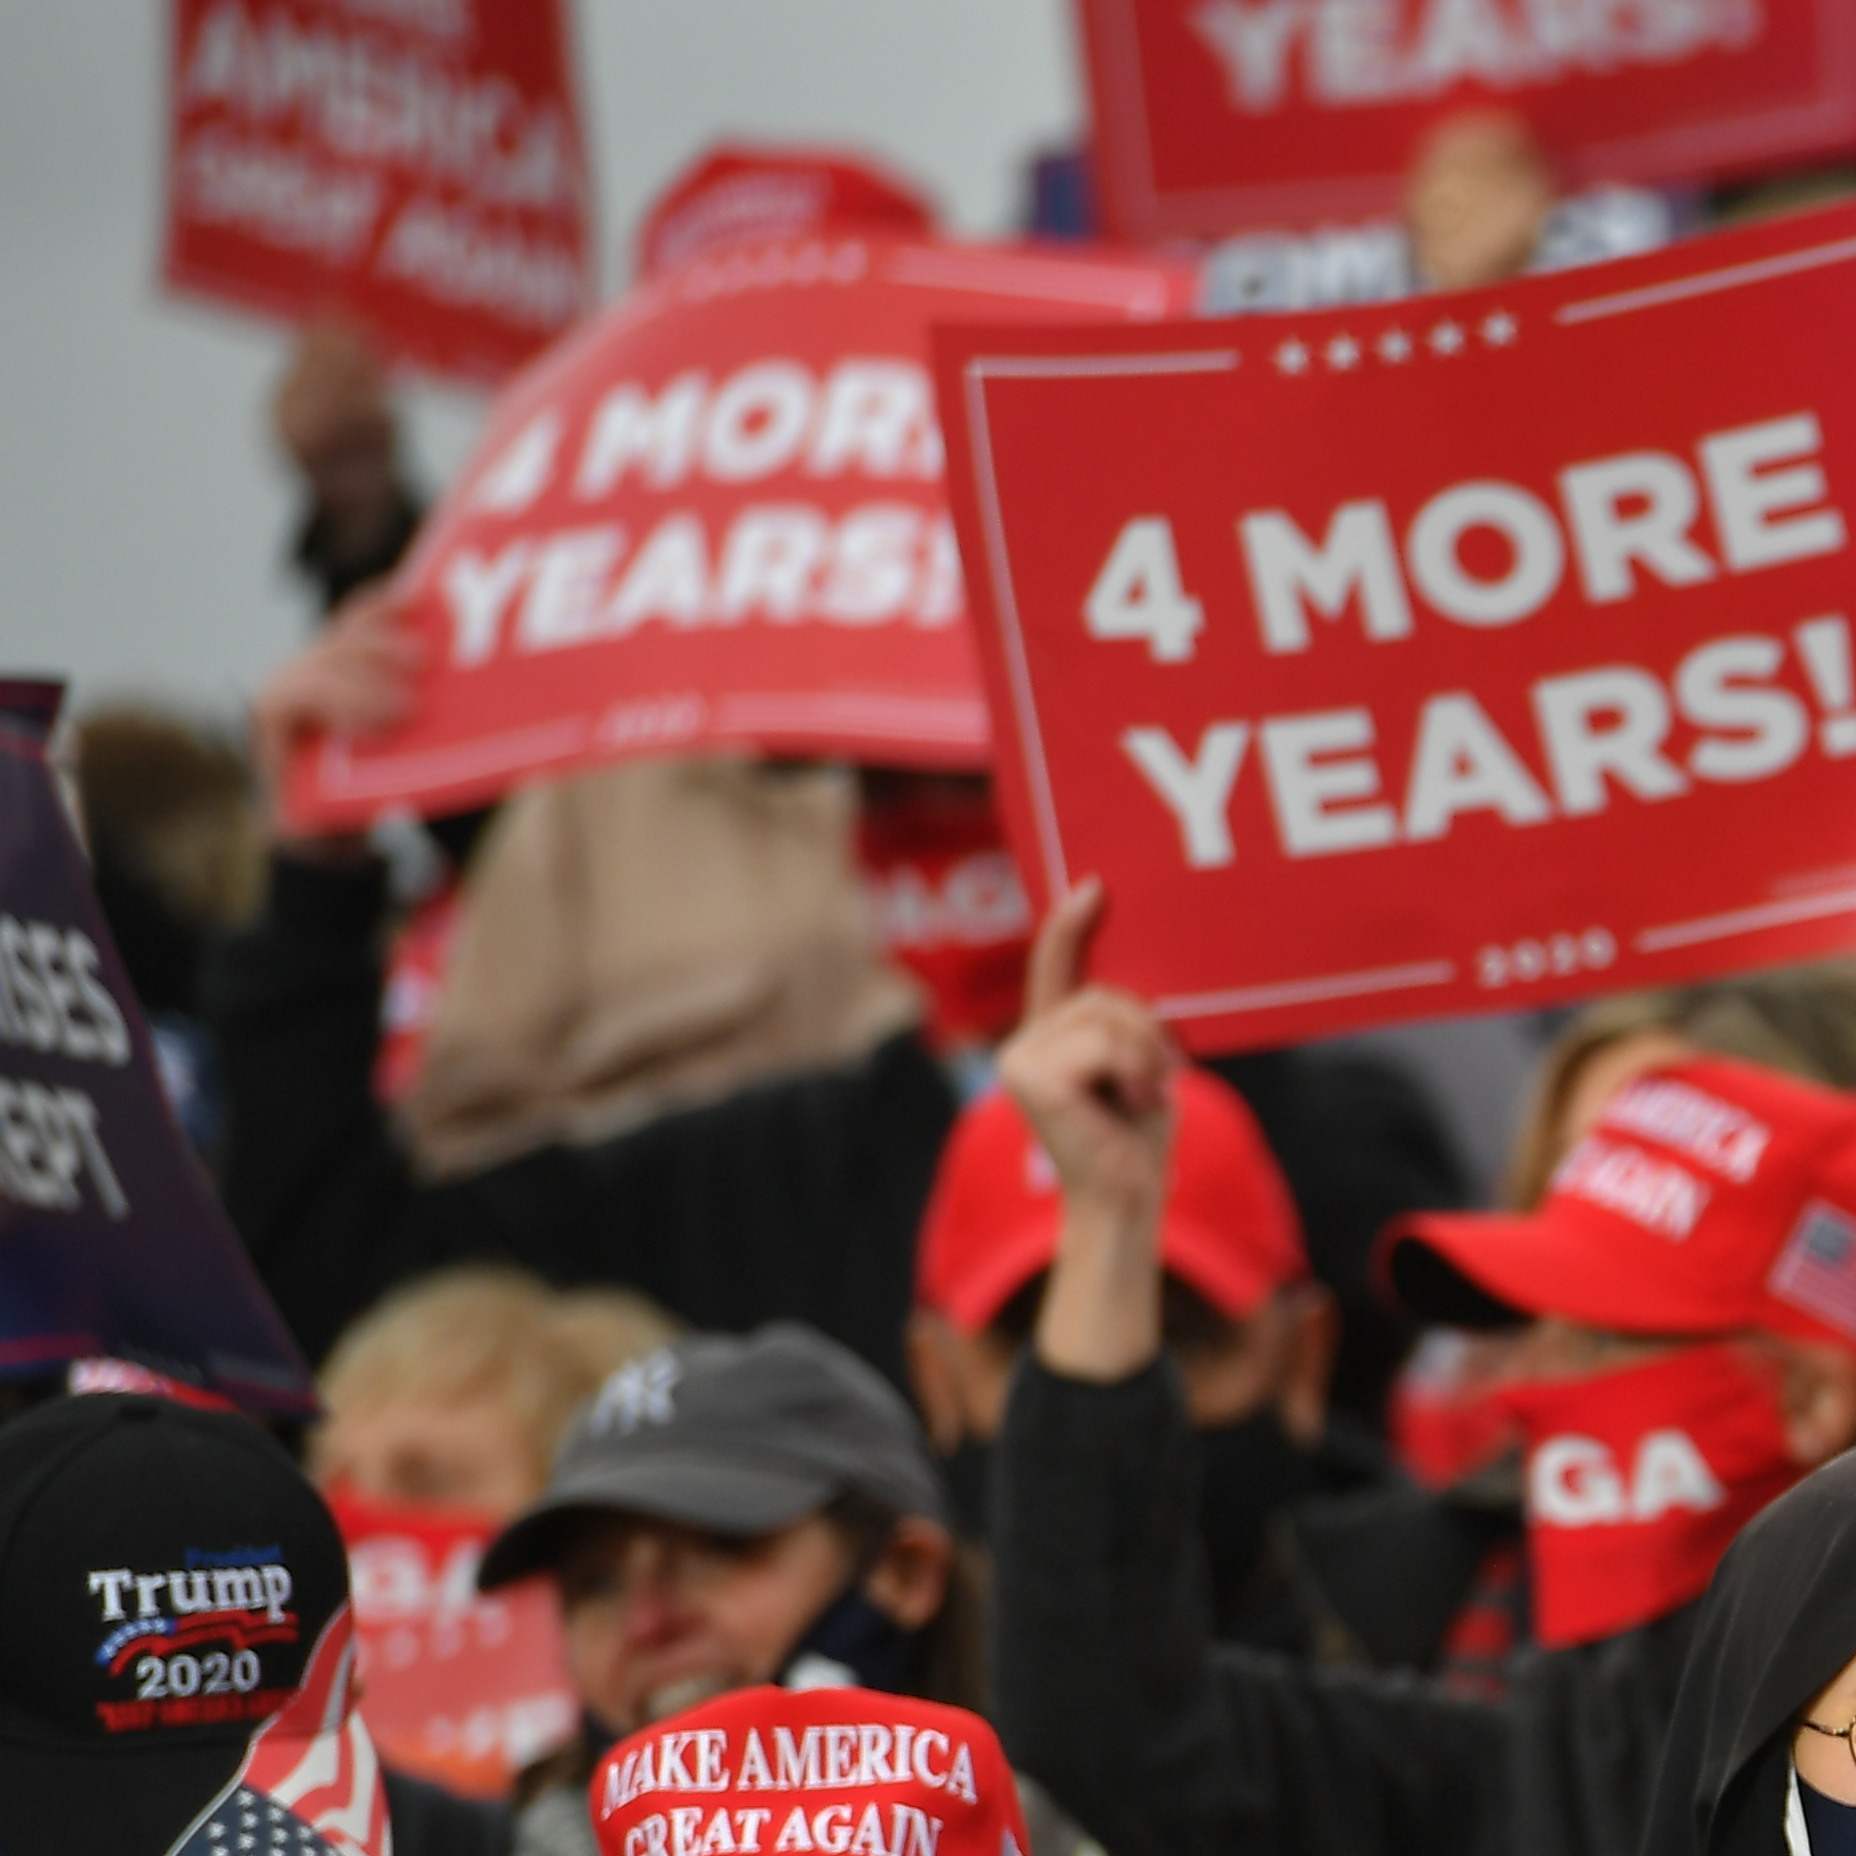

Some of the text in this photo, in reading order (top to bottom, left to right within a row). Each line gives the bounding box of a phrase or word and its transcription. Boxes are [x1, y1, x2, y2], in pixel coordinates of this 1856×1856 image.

[572, 358, 945, 502] MOR
[1082, 411, 1848, 664] 4 MORE
[1474, 922, 1619, 992] 2020
[88, 1564, 292, 1624] Trump
[135, 1648, 262, 1699] 2020
[601, 1728, 731, 1821] MAKE
[736, 1723, 979, 1806] AMERICA
